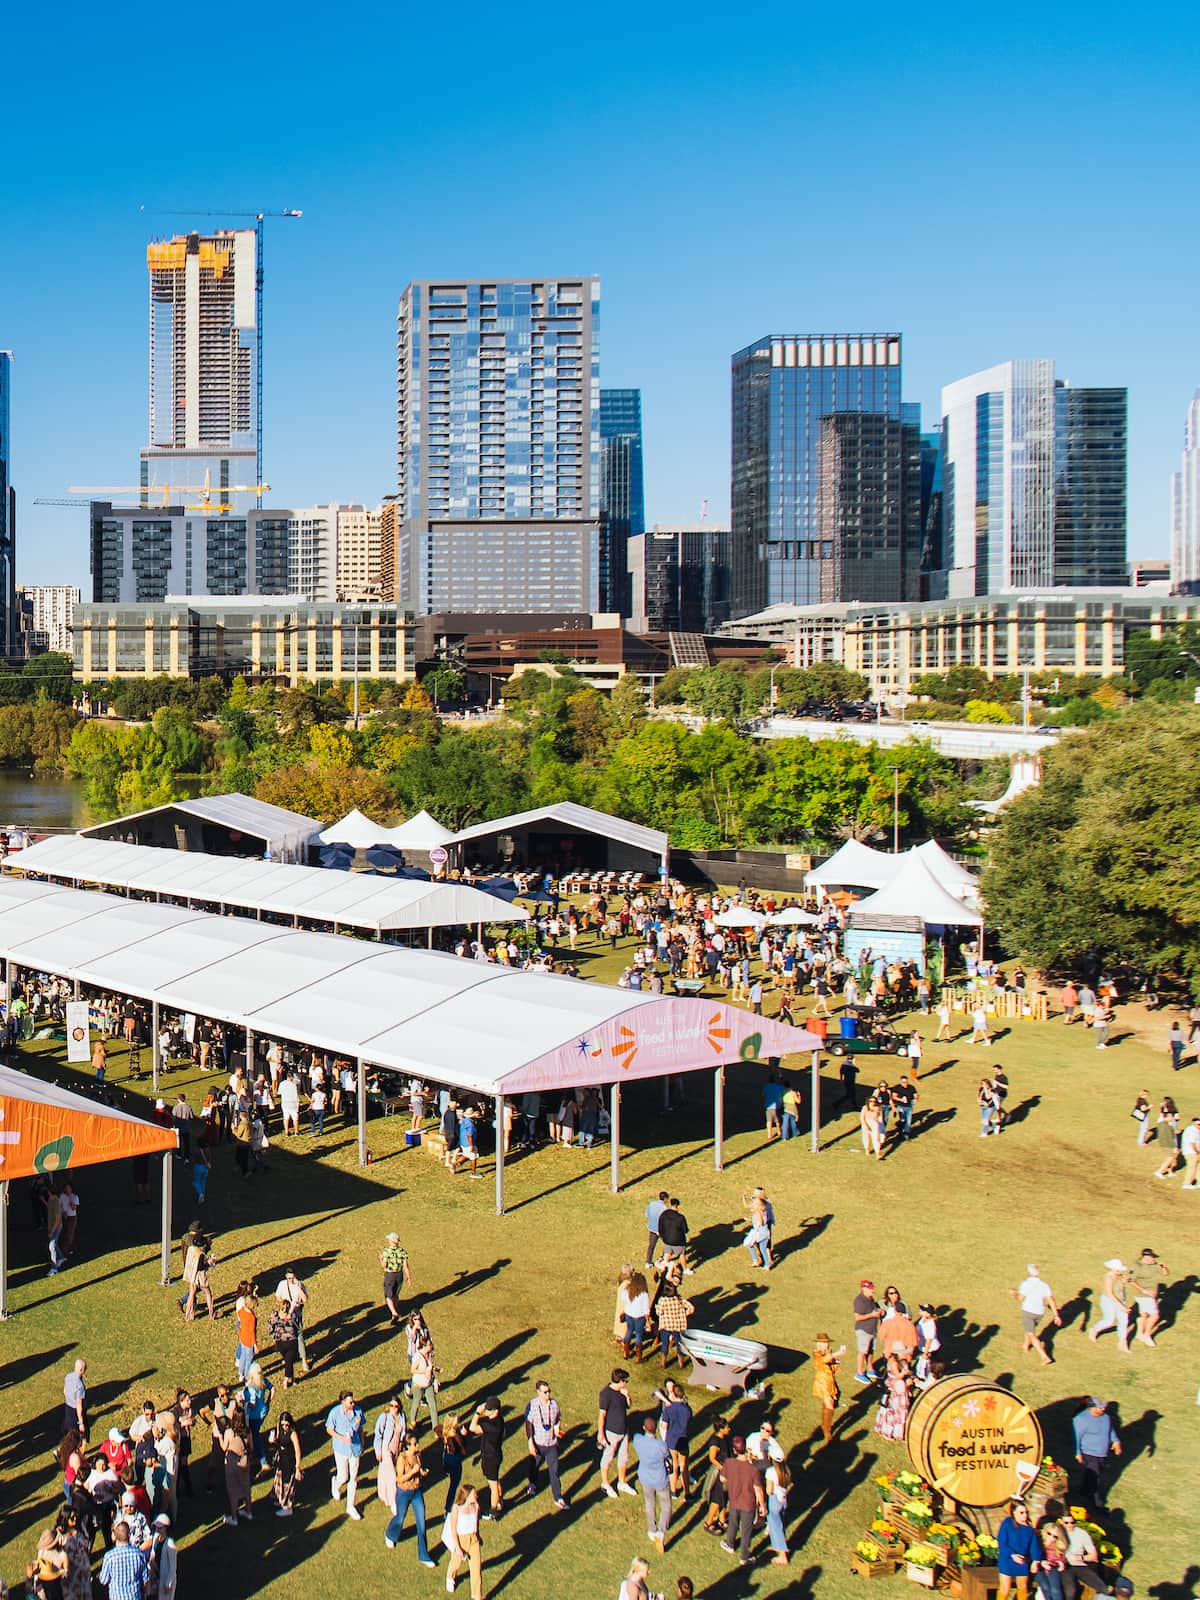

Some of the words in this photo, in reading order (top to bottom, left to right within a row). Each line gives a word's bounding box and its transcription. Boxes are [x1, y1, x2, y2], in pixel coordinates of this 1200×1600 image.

[960, 1427, 1004, 1439] AUSTIN
[938, 1440, 976, 1458] food
[980, 1445, 987, 1454] &
[990, 1441, 1034, 1455] wine
[955, 1459, 1009, 1471] FESTIVAL
